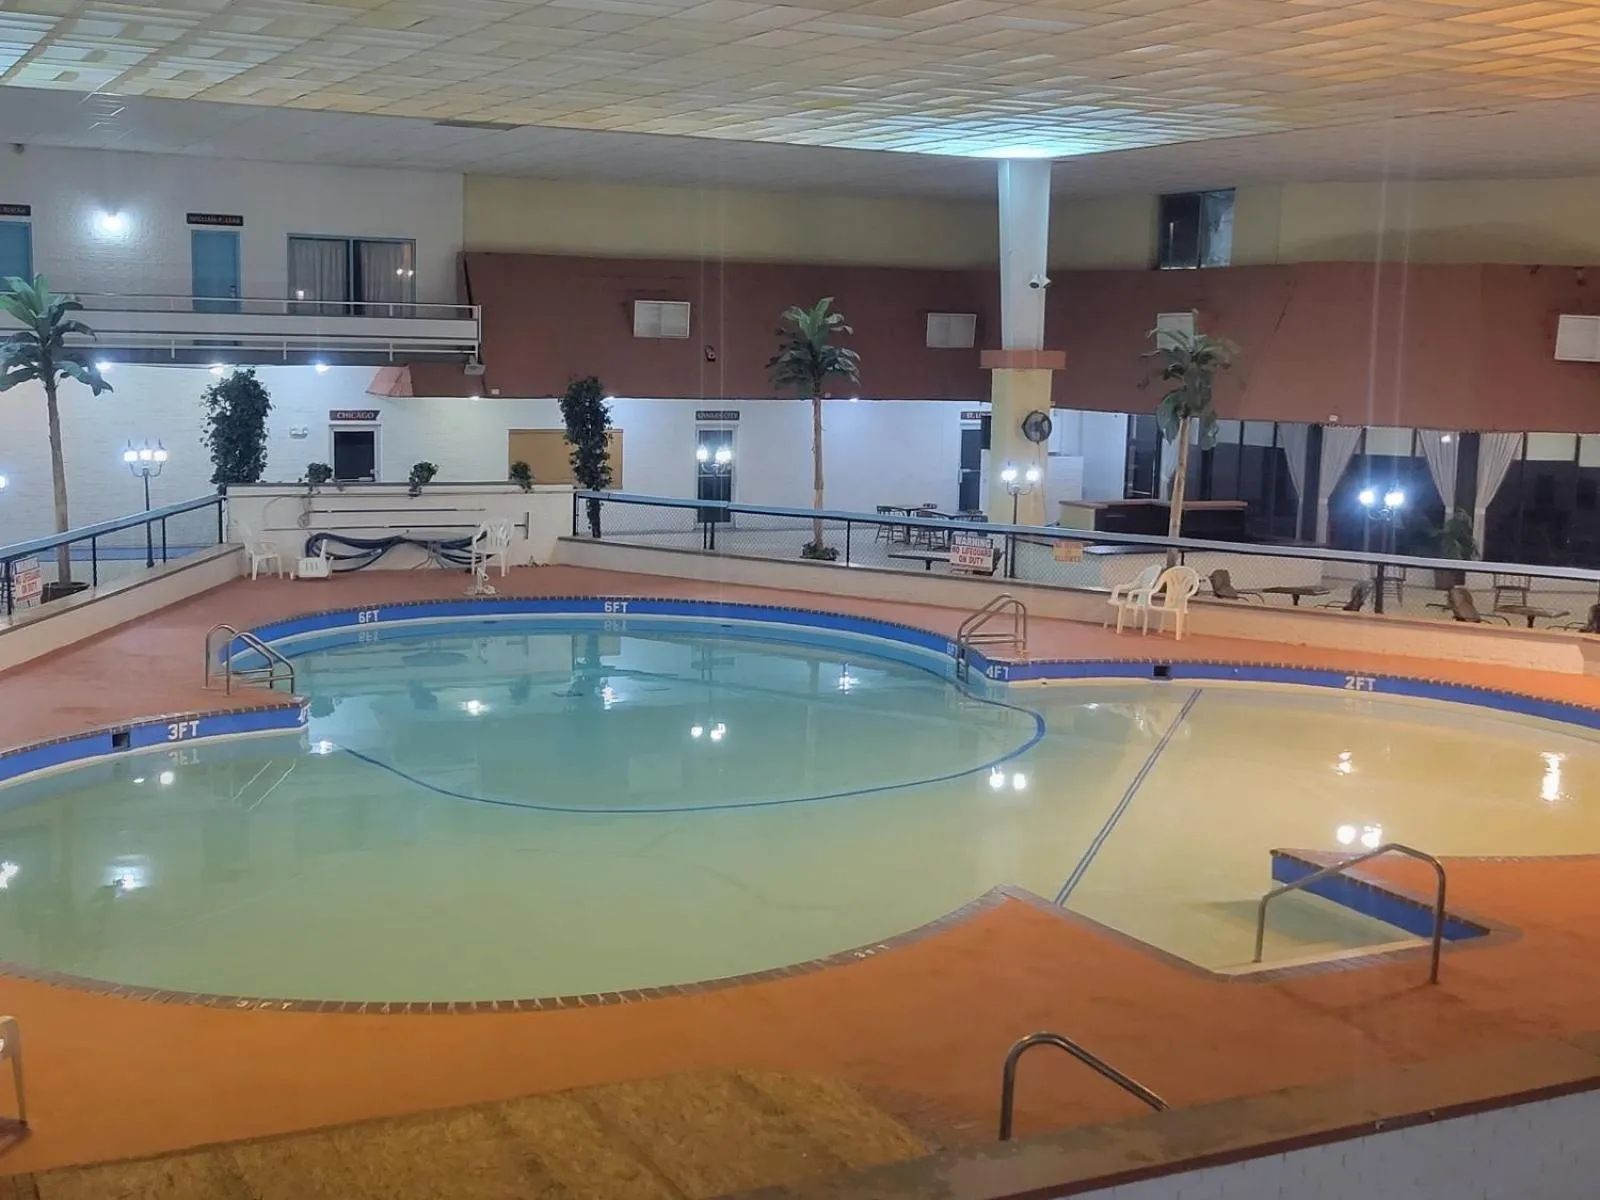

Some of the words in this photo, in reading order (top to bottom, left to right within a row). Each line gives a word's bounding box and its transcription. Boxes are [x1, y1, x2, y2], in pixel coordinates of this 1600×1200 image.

[336, 411, 375, 419] CHICAGO
[955, 535, 991, 547] WARNING
[961, 547, 992, 557] LIFEGUARD
[959, 555, 967, 563] ON
[968, 557, 984, 565] DUTY
[604, 601, 628, 614] 6FT
[359, 609, 380, 623] 6FT
[986, 665, 1009, 680] 4FT
[1344, 676, 1376, 691] 2FT
[168, 720, 200, 740] 3FT
